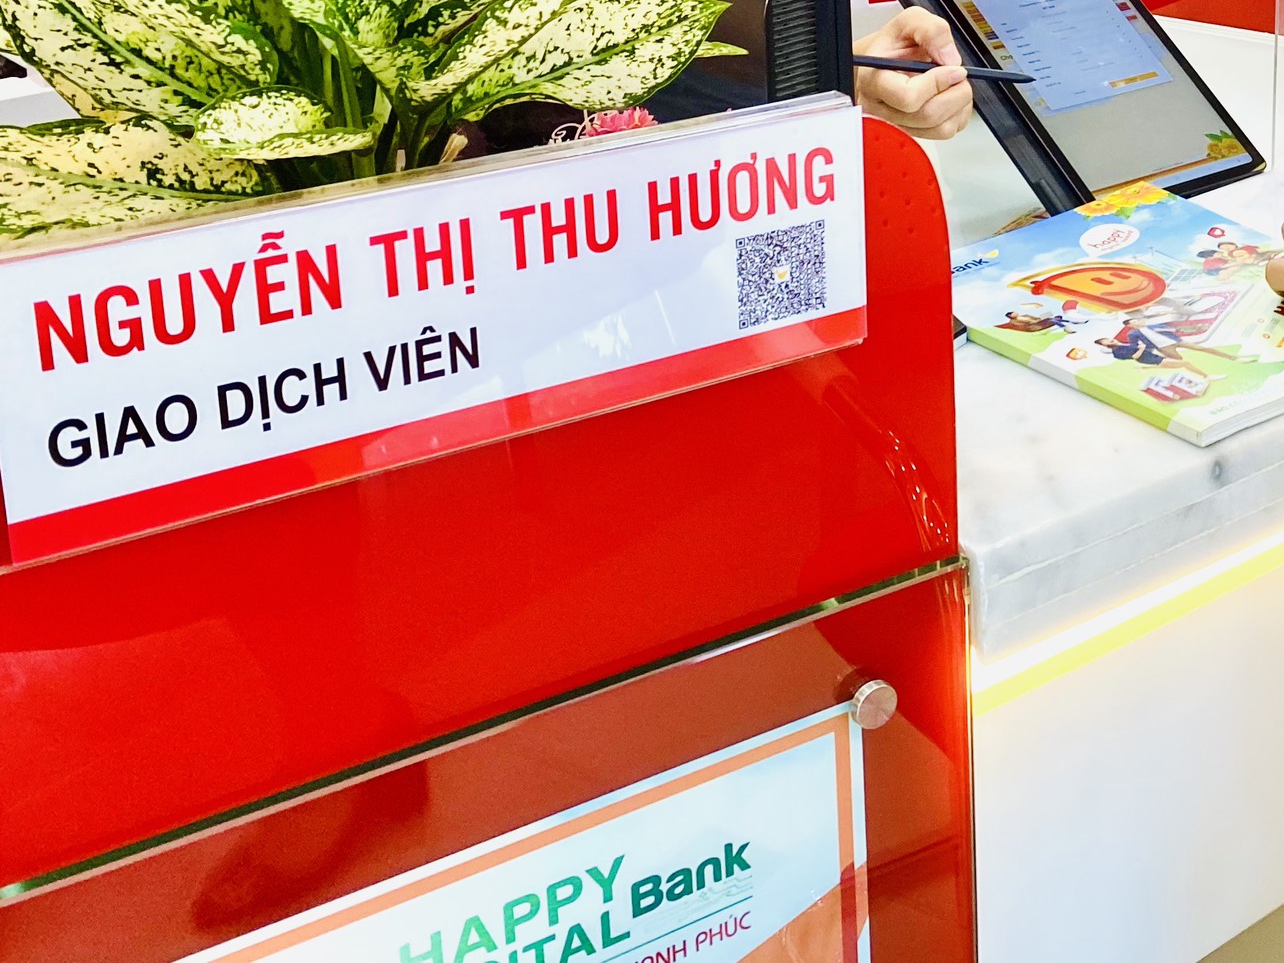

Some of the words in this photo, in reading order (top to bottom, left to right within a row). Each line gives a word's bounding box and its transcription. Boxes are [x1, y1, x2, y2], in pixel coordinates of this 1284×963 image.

[33, 230, 343, 373] NGUYỄN
[370, 218, 476, 297] THỊ
[500, 187, 621, 272] THU
[648, 145, 837, 242] HƯƠNG
[47, 392, 198, 470] GIAO
[216, 354, 350, 433] DỊCH
[363, 324, 482, 394] VIÊN
[400, 853, 626, 963] HAPPY
[631, 841, 752, 918] Bank
[695, 910, 752, 952] PHÚC
